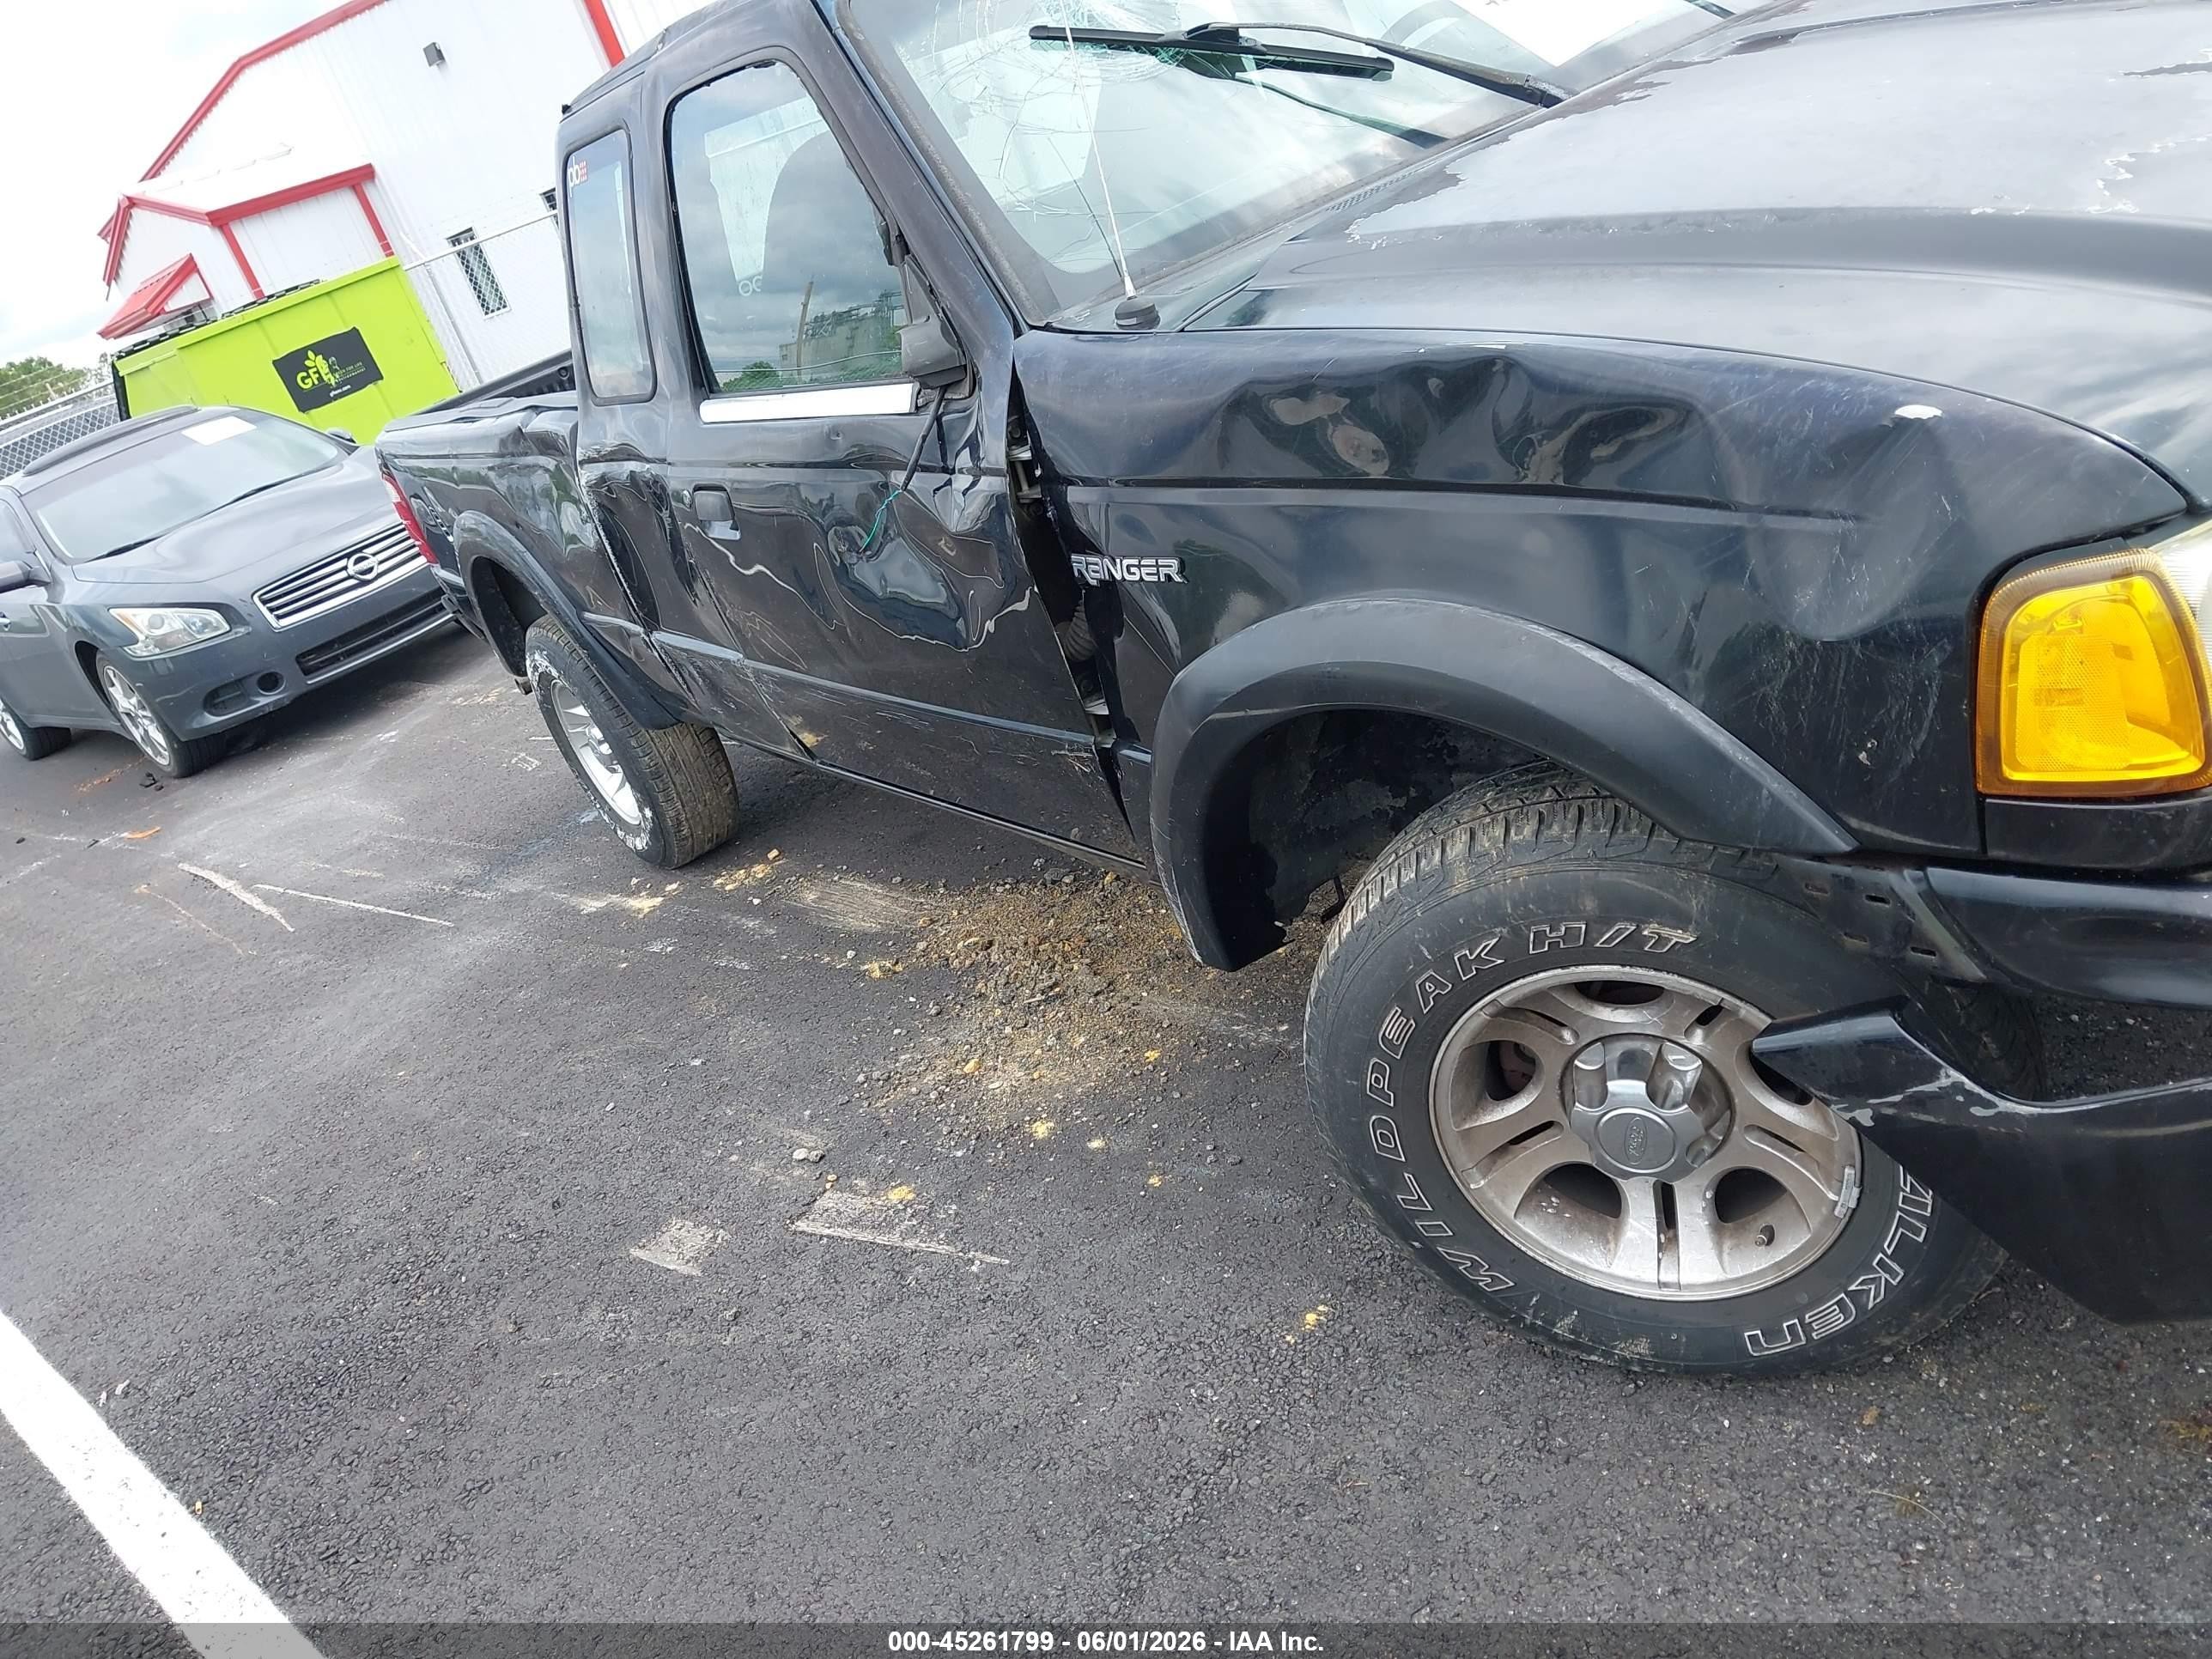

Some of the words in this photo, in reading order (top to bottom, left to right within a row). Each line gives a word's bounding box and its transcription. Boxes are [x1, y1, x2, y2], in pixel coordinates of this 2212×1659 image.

[1071, 554, 1188, 586] RANGER
[1366, 935, 1516, 1291] WILDPEAK
[1528, 922, 1698, 954] H/T
[1744, 1164, 1933, 1357] ALKEN
